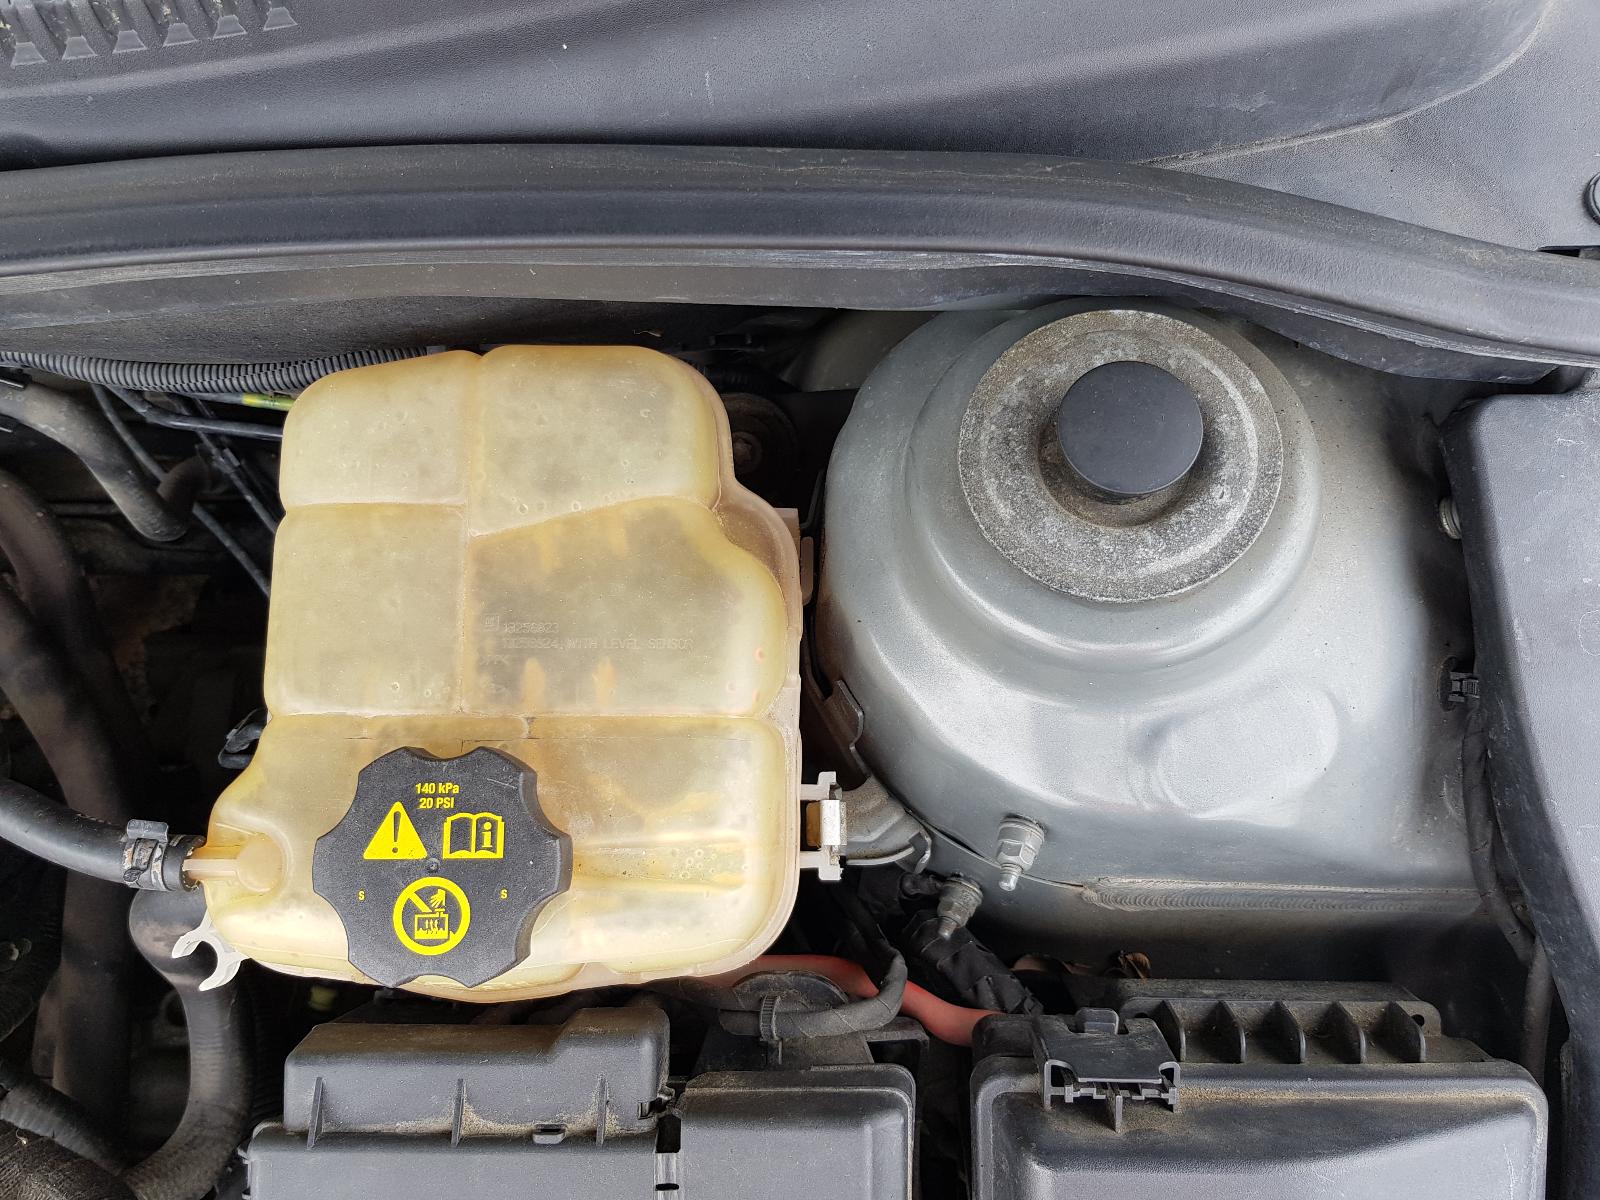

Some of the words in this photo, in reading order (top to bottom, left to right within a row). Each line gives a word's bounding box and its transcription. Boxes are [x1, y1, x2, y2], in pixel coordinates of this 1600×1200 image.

[415, 783, 437, 794] 140
[439, 782, 460, 794] kPa
[418, 797, 433, 809] 20
[436, 797, 455, 809] PSI
